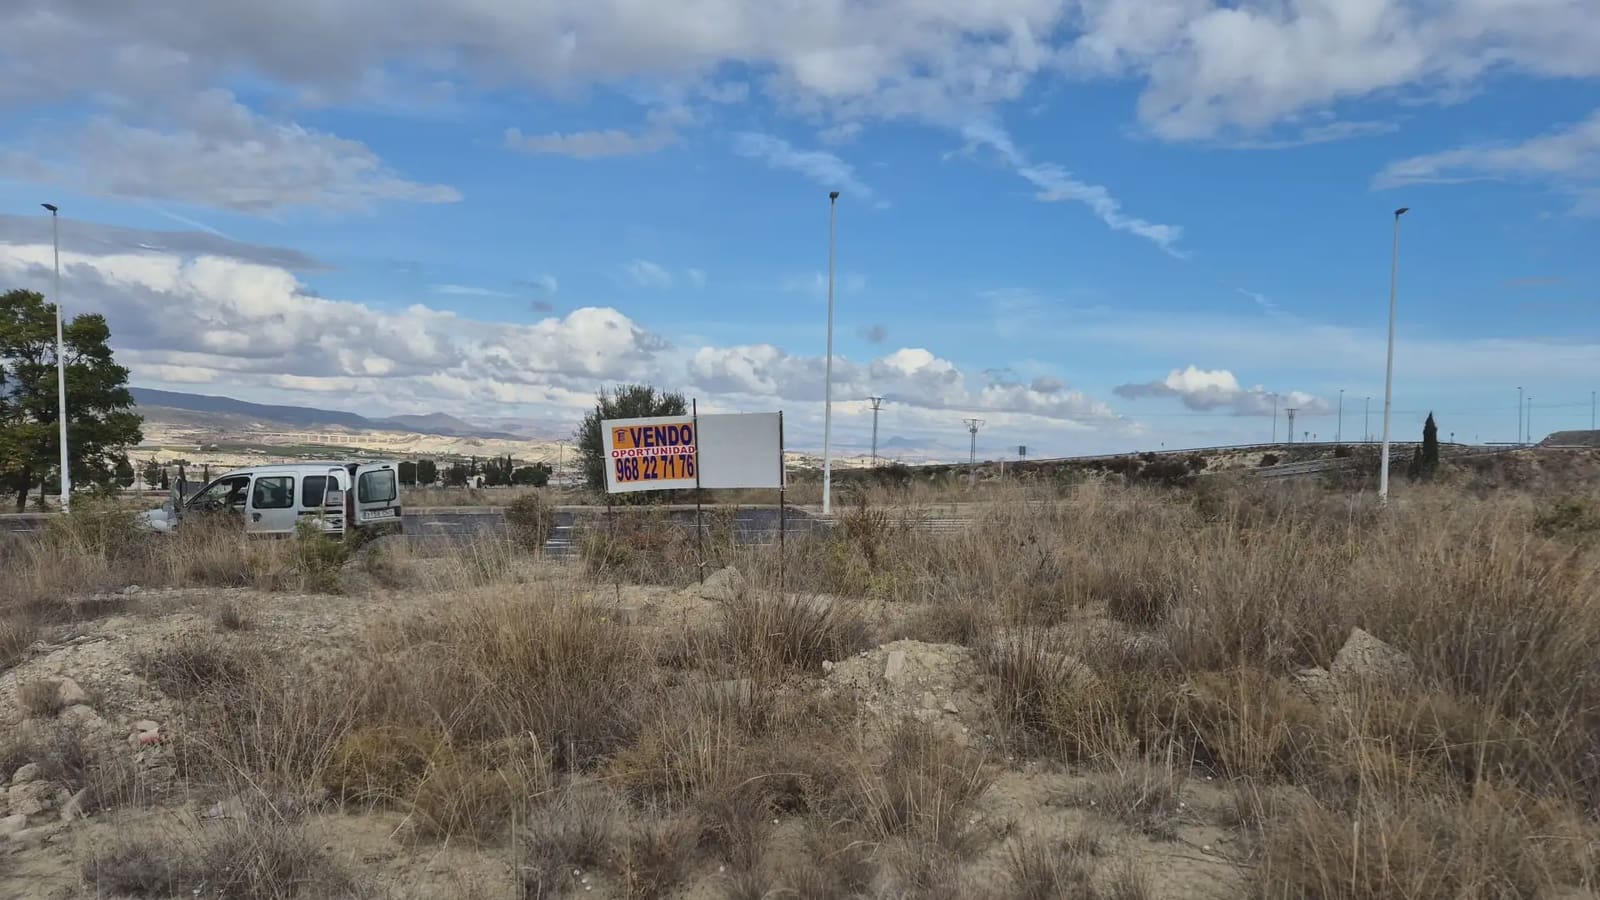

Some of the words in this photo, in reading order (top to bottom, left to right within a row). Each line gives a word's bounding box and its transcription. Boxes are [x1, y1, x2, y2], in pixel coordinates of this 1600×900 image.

[630, 424, 692, 448] VENDO
[611, 446, 695, 458] OPORTUNIDAD
[616, 457, 639, 482] 968
[643, 455, 658, 479] 22
[660, 455, 675, 478] 71
[679, 454, 694, 478] 76
